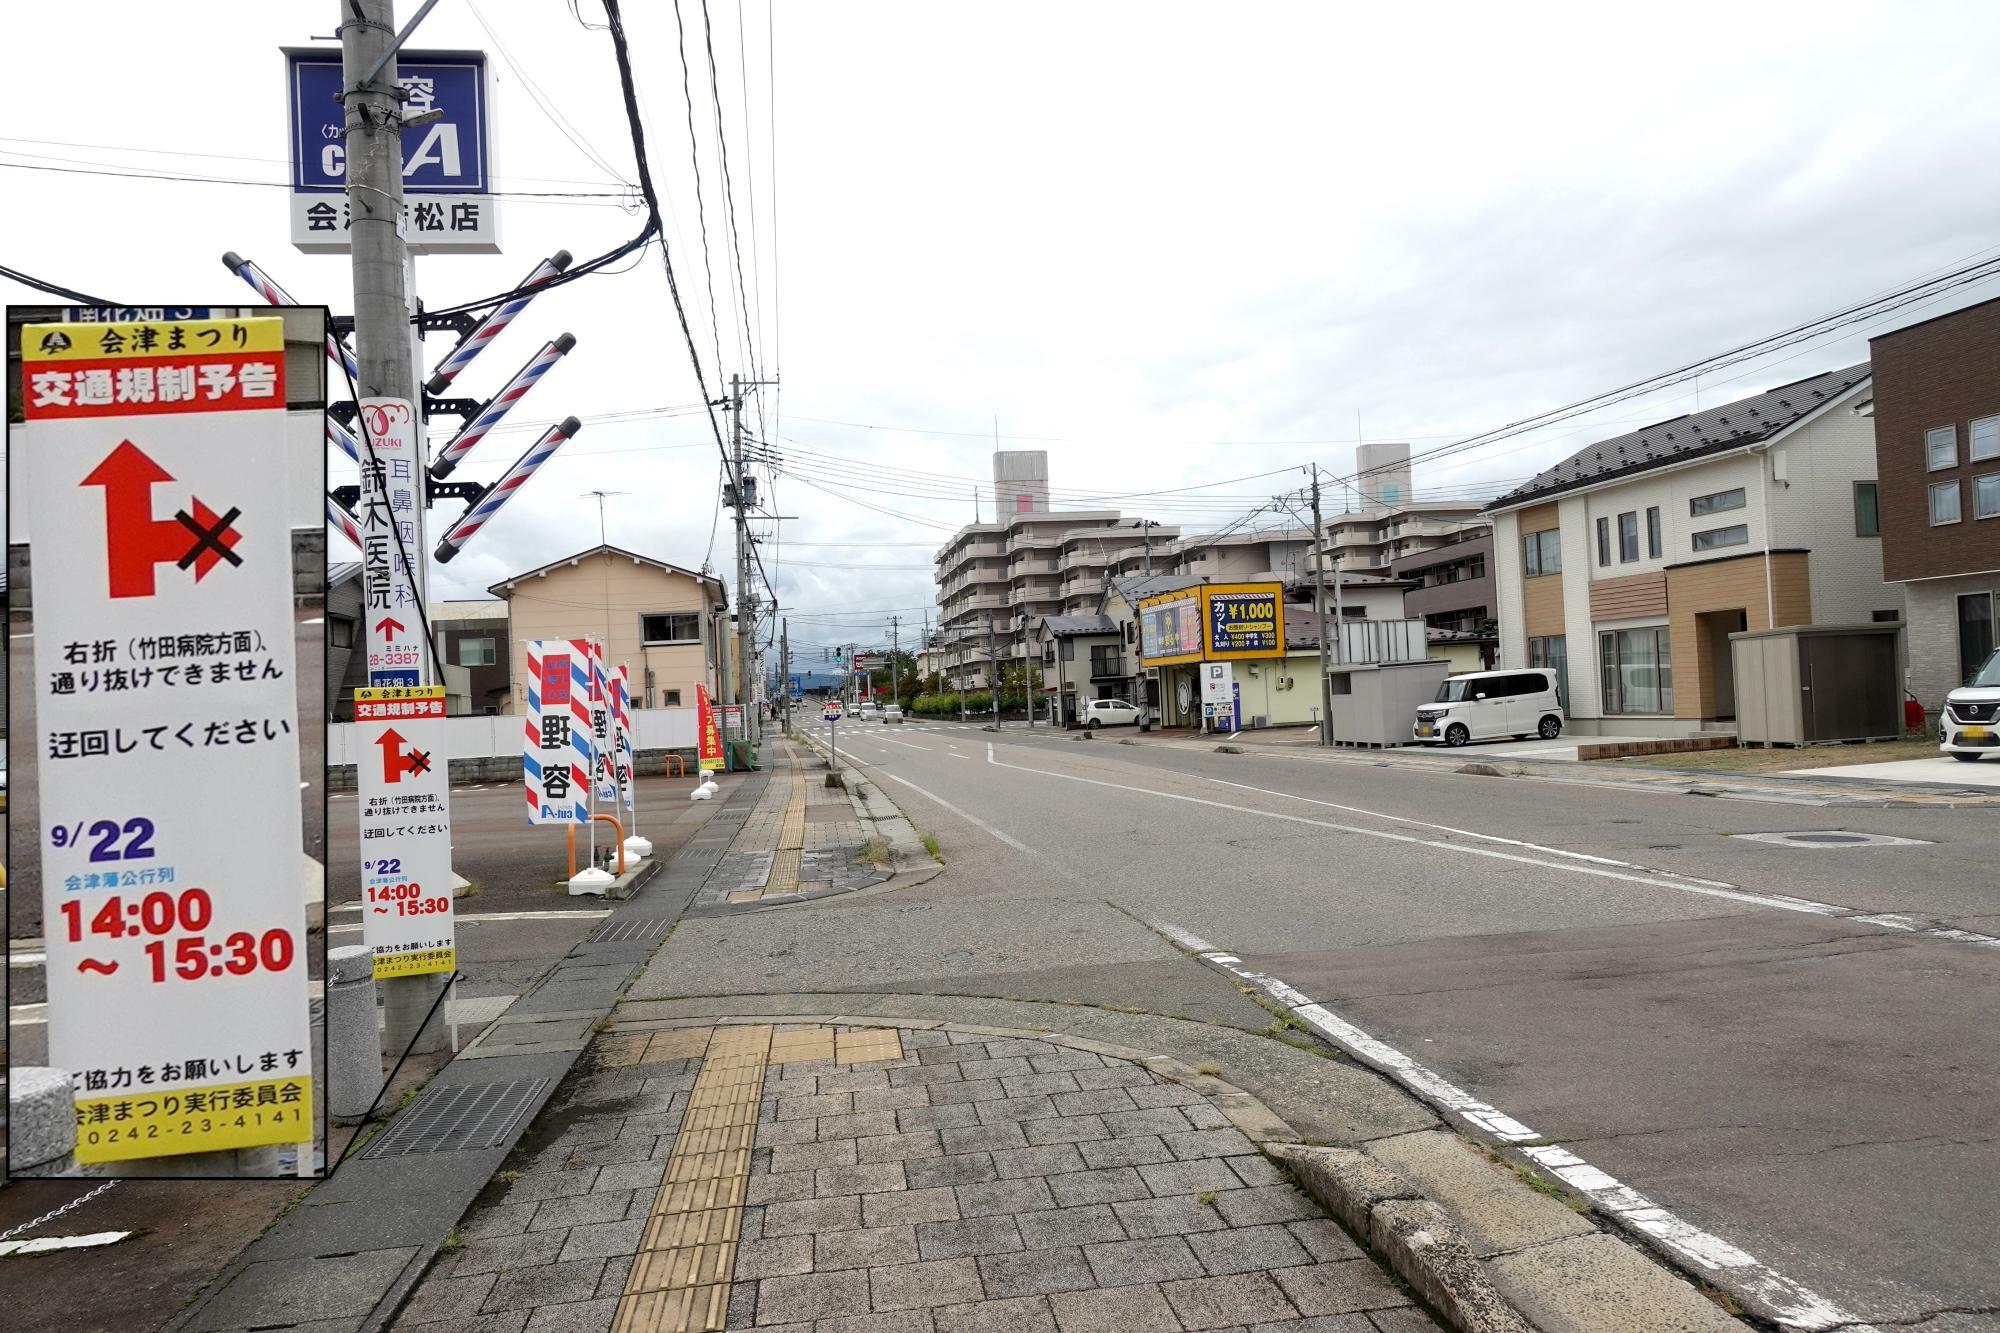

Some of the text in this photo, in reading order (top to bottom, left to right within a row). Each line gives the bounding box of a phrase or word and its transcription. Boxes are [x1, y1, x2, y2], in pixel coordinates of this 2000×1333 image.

[307, 202, 479, 232] 会松店
[99, 323, 249, 354] 会津まつり
[31, 362, 278, 407] 交通規制予告
[362, 457, 391, 610] 鈴木医院
[1214, 601, 1226, 634] カット
[1228, 602, 1274, 620] ¥1,000
[369, 653, 419, 667] 28-3387
[50, 658, 284, 695] 通り抜けできません
[382, 689, 434, 699] 会津まつり
[357, 702, 443, 717] 交通規制予告
[49, 718, 291, 760] 迂回してください
[364, 803, 446, 817] 通り抜けできません
[51, 816, 155, 863] 9/22
[363, 824, 448, 839] 迂回してください
[364, 859, 401, 875] 9/22
[368, 883, 421, 902] 14:00
[61, 888, 213, 943] 14:00
